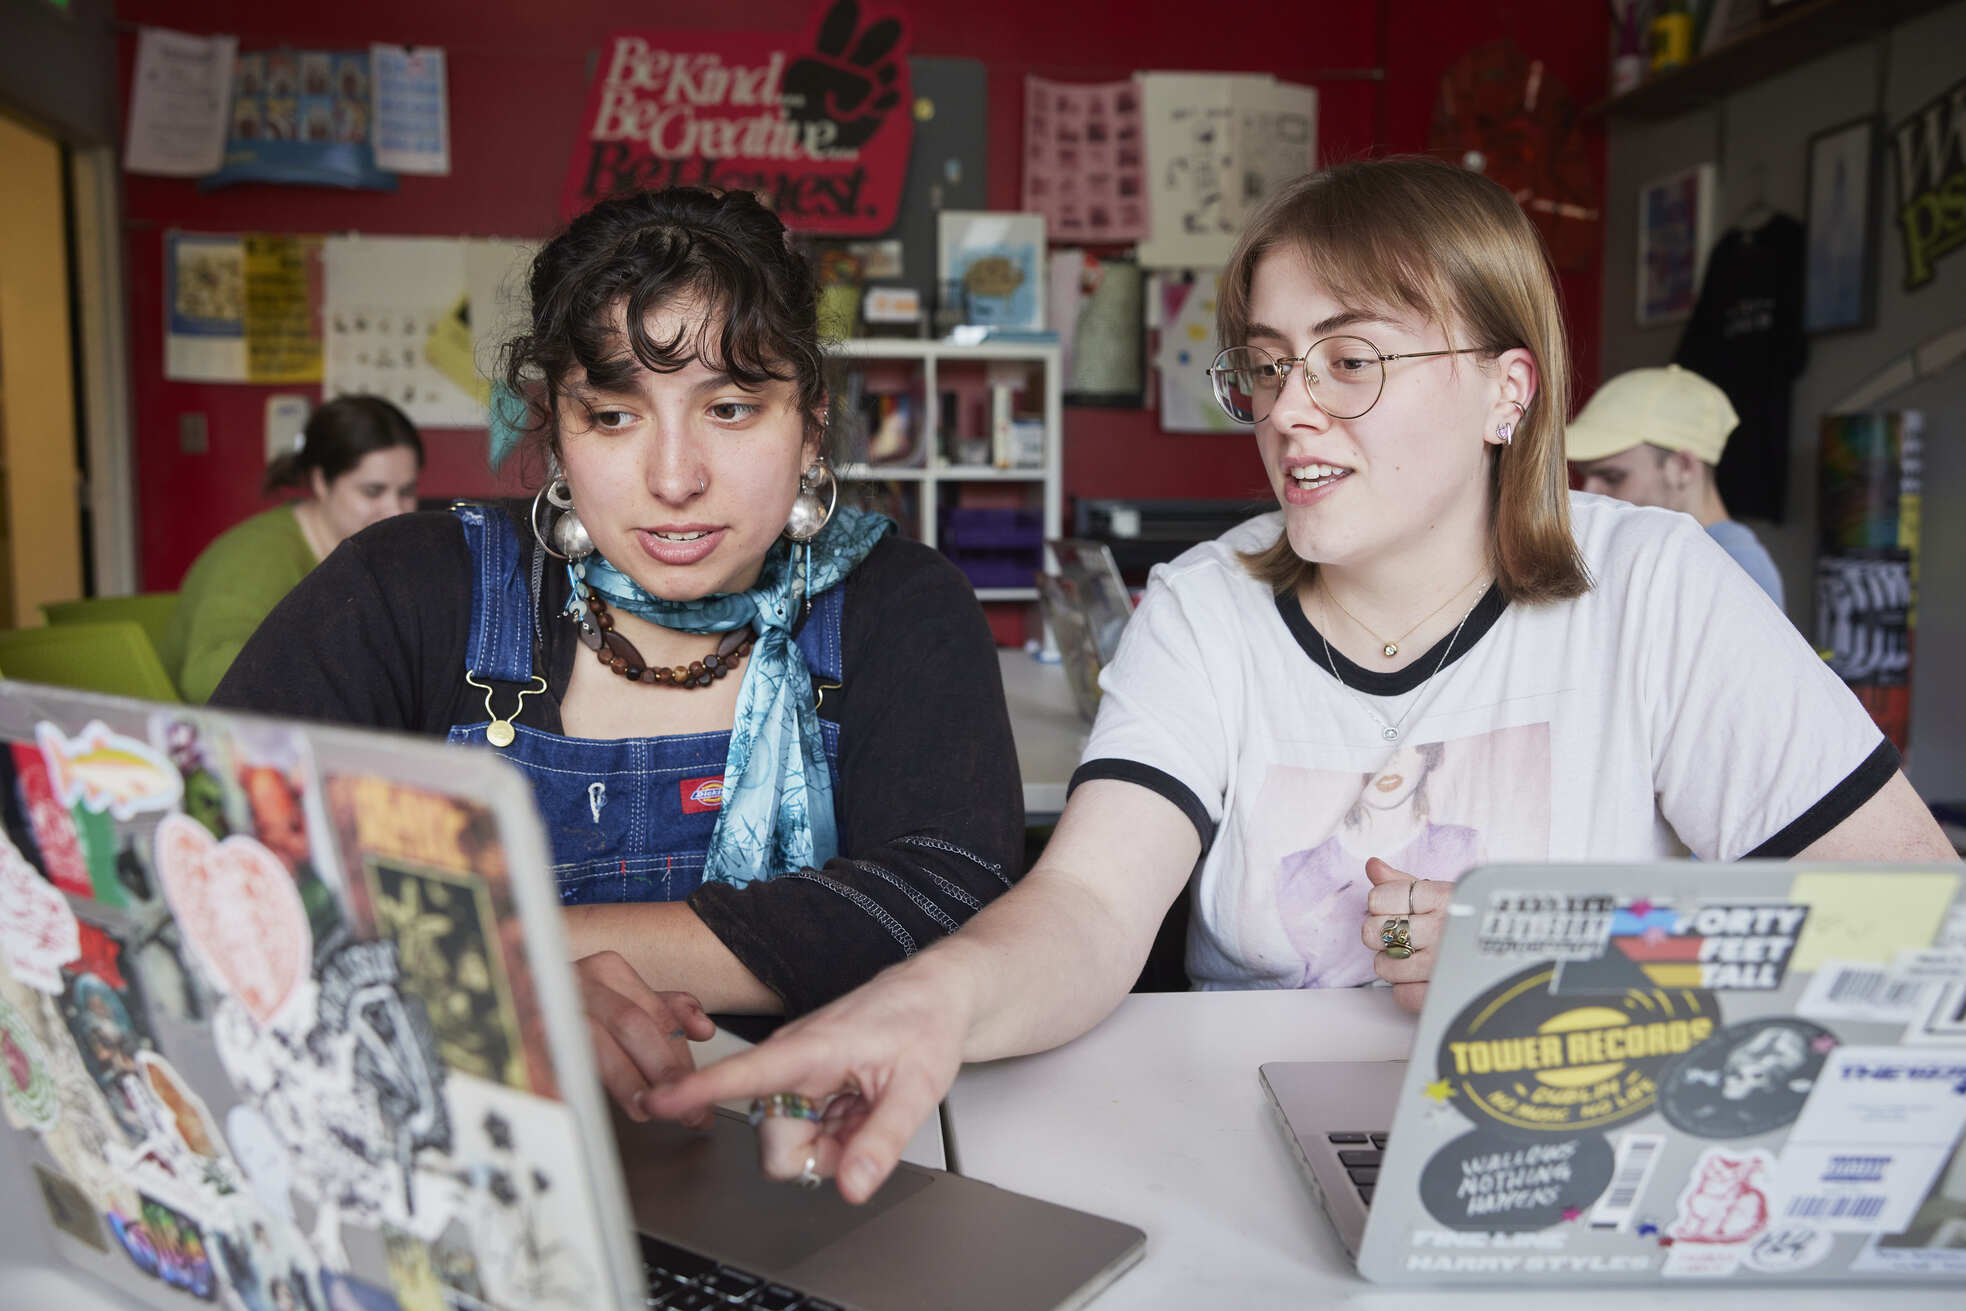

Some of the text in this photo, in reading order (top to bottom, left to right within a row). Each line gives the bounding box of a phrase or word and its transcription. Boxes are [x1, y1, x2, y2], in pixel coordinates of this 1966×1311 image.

[605, 37, 668, 91] Be
[591, 89, 658, 142] Be
[1672, 908, 1806, 935] FORTY
[1699, 936, 1796, 961] FEET
[1700, 962, 1780, 988] TALL
[1450, 1017, 1713, 1075] TOWER RECORDS
[1462, 1140, 1580, 1176] WALLOWS
[1456, 1162, 1572, 1199] NOTHING
[1407, 1254, 1650, 1273] HARRY STYLES
